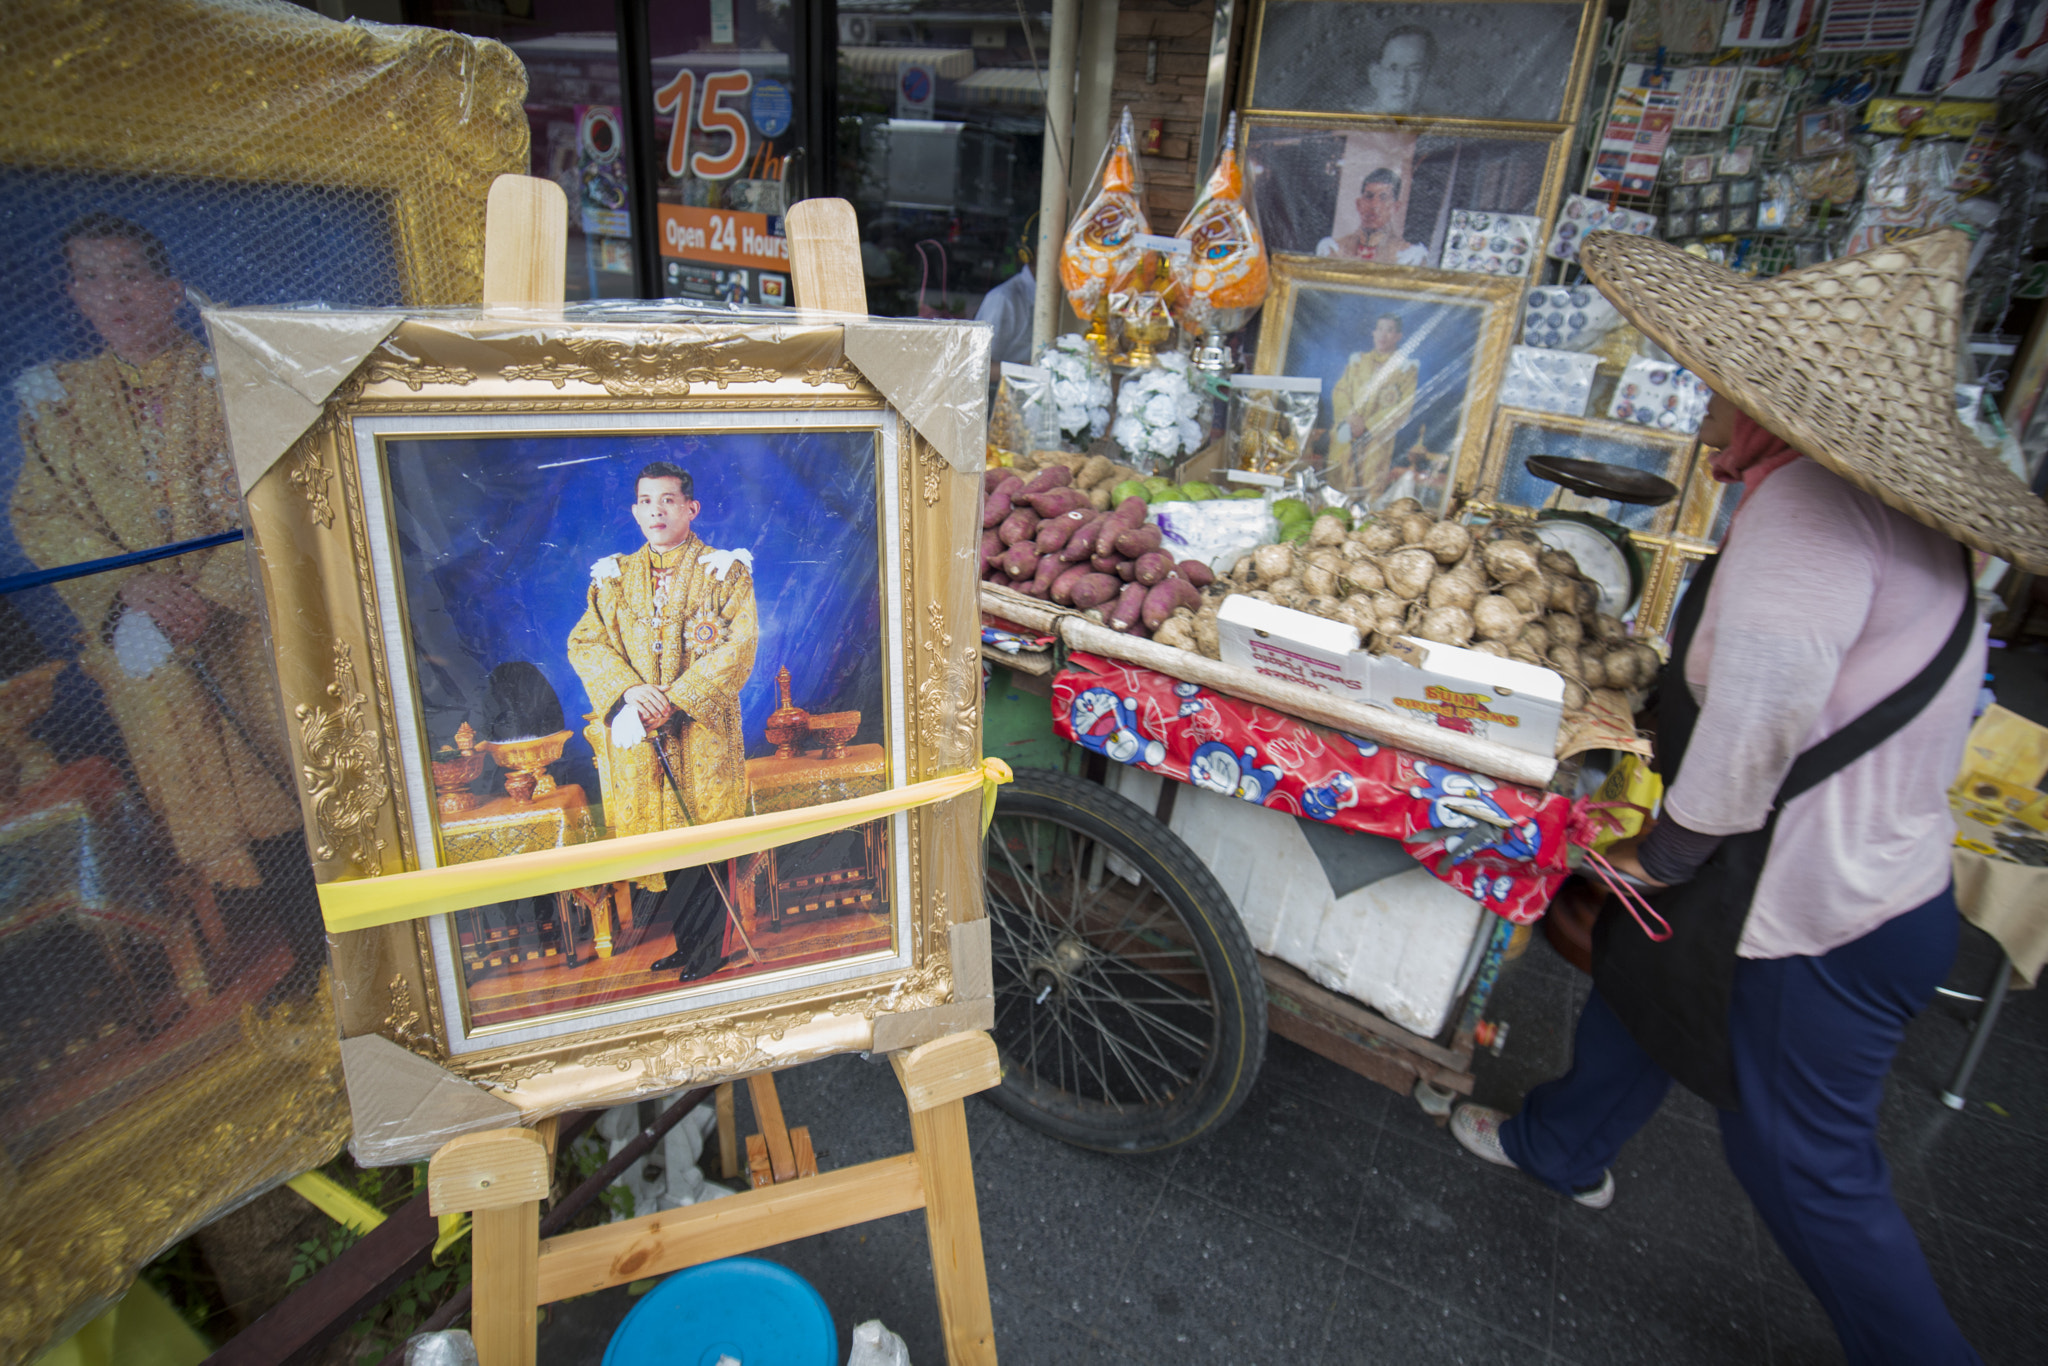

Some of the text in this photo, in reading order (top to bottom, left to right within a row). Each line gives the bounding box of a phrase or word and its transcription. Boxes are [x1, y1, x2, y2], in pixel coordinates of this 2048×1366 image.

[654, 68, 751, 179] 15
[666, 217, 705, 253] Open
[709, 214, 737, 253] 24
[742, 226, 789, 259] Hours
[1252, 652, 1304, 677] Potato
[1254, 666, 1328, 691] Japanese
[1311, 669, 1362, 690] Sweet
[1424, 685, 1480, 710] King
[1392, 697, 1519, 728] Sweet Potato
